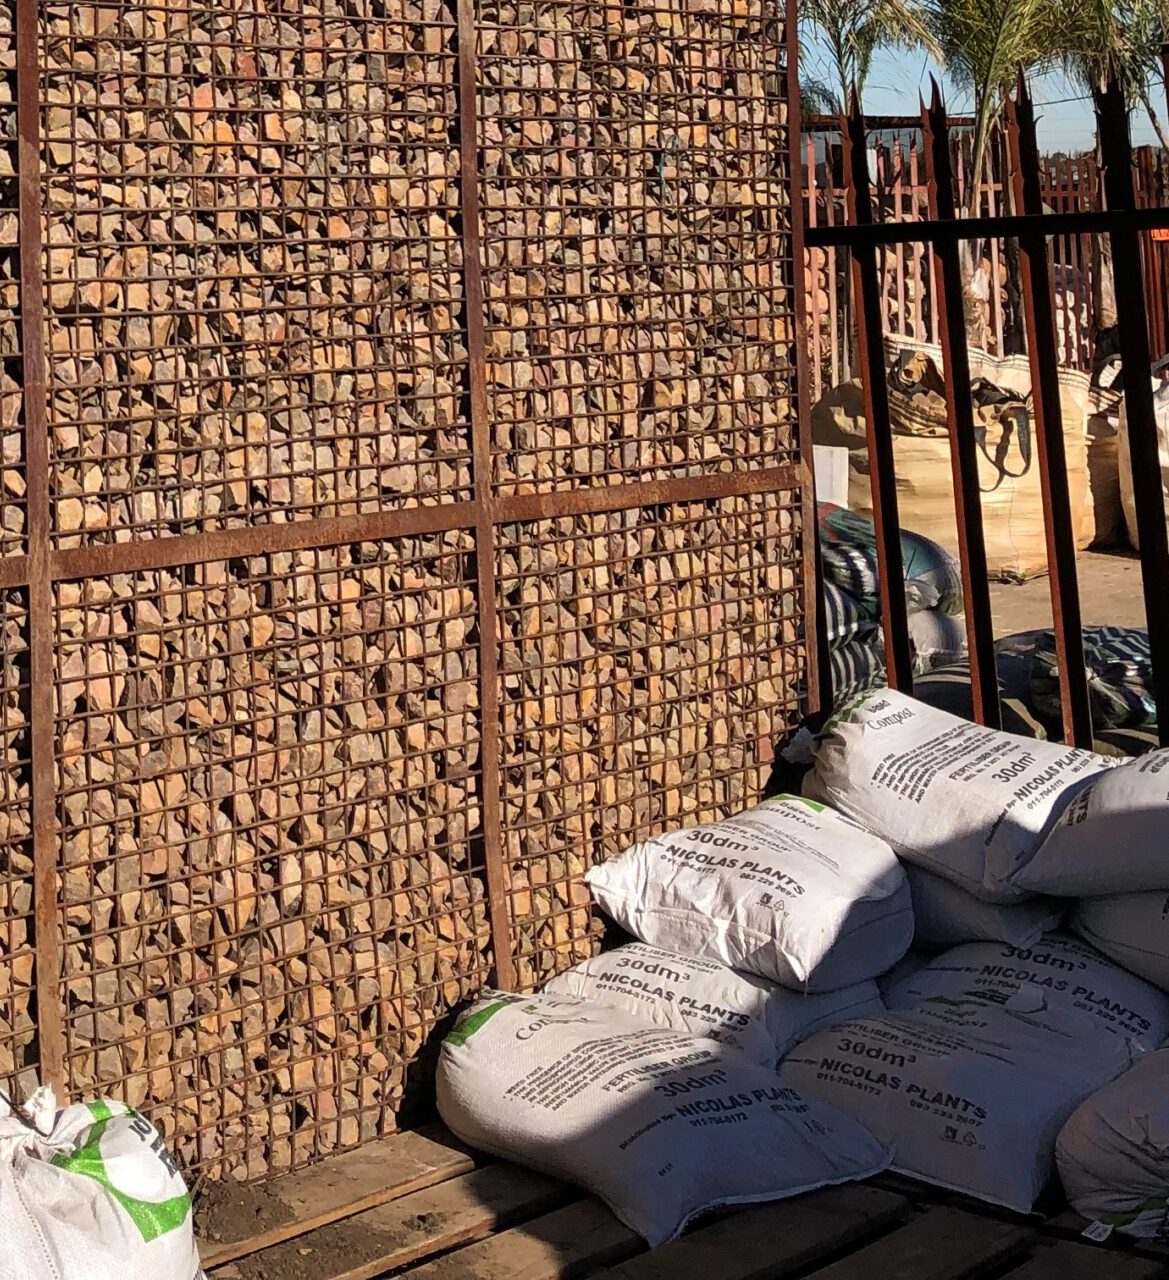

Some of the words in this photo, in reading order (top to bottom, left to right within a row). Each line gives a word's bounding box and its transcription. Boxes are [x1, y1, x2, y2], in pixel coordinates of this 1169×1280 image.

[867, 707, 916, 730] Compost
[1013, 763, 1060, 803] NICOLAS
[1058, 747, 1086, 773] PLANT
[759, 806, 821, 831] ompost
[665, 844, 739, 869] NICOLAS
[740, 861, 806, 896] PLANTS
[680, 956, 723, 971] GROUP
[595, 983, 656, 1004] 011-704-5172
[599, 972, 676, 1002] NICOLAS
[679, 996, 751, 1026] PLANTS
[980, 965, 1068, 992] NICOLAS
[1071, 985, 1151, 1031] PLANTS
[601, 1061, 673, 1091] FERTILISER
[671, 1050, 711, 1066] GROUP
[819, 1057, 901, 1090] NICOLAS
[906, 1083, 988, 1120] PLANTS
[676, 1090, 753, 1118] NICOLAS
[752, 1086, 802, 1104] PLANTS
